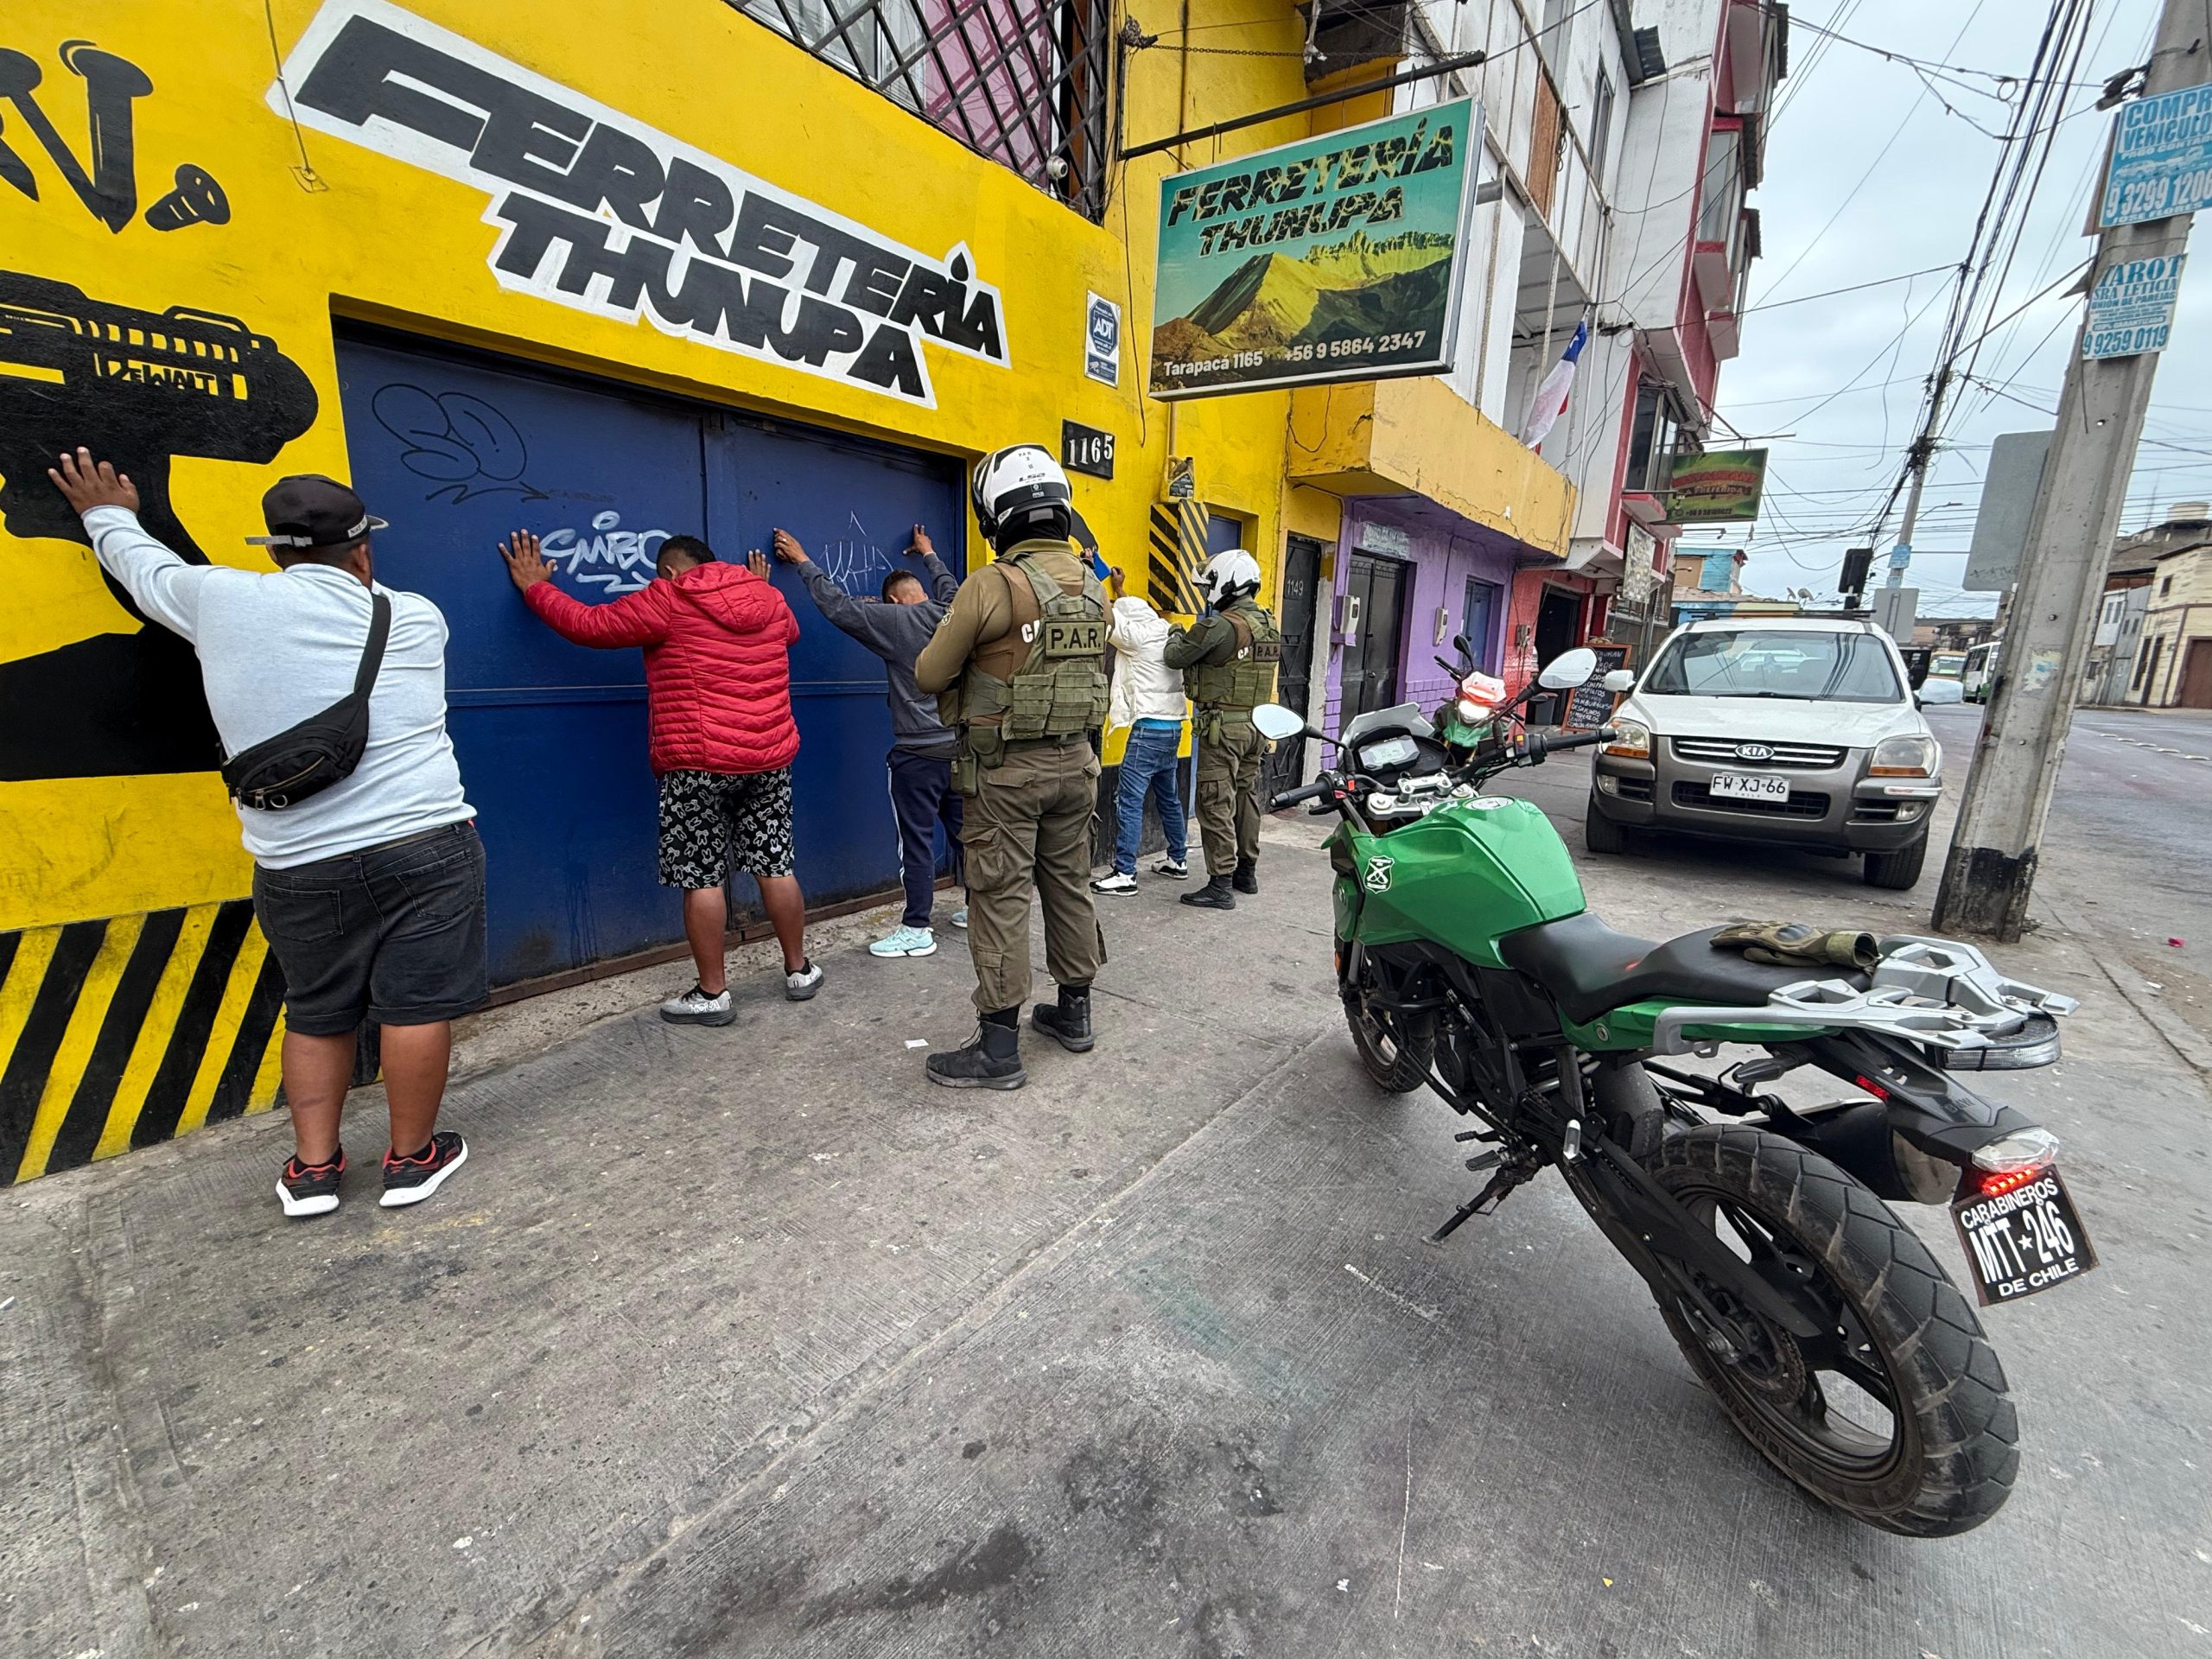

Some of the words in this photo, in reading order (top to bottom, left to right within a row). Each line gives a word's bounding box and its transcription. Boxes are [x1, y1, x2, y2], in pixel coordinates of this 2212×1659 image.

[2120, 176, 2171, 215] 3299
[1198, 186, 1404, 257] THUNUPA
[495, 193, 927, 398] THUNUPA
[2123, 277, 2177, 296] LETICIA
[1094, 317, 1114, 340] ADT
[2094, 329, 2133, 354] 9259
[2134, 324, 2169, 350] 0119
[1164, 354, 1230, 377] Tarapacá
[1233, 351, 1263, 369] 1165
[1284, 343, 1313, 362] +56
[1316, 342, 1327, 359] 9
[1330, 337, 1375, 357] 5864
[1378, 330, 1427, 353] 2347
[1067, 434, 1113, 467] 1165
[1287, 581, 1304, 596] 1149
[1051, 627, 1102, 650] P.A.R.
[1742, 747, 1767, 756] KIA
[689, 1000, 721, 1014] HOKA
[1961, 1178, 2058, 1229] CARABINEROS
[1999, 1278, 2027, 1296] DE
[2029, 1258, 2080, 1287] CHILE
